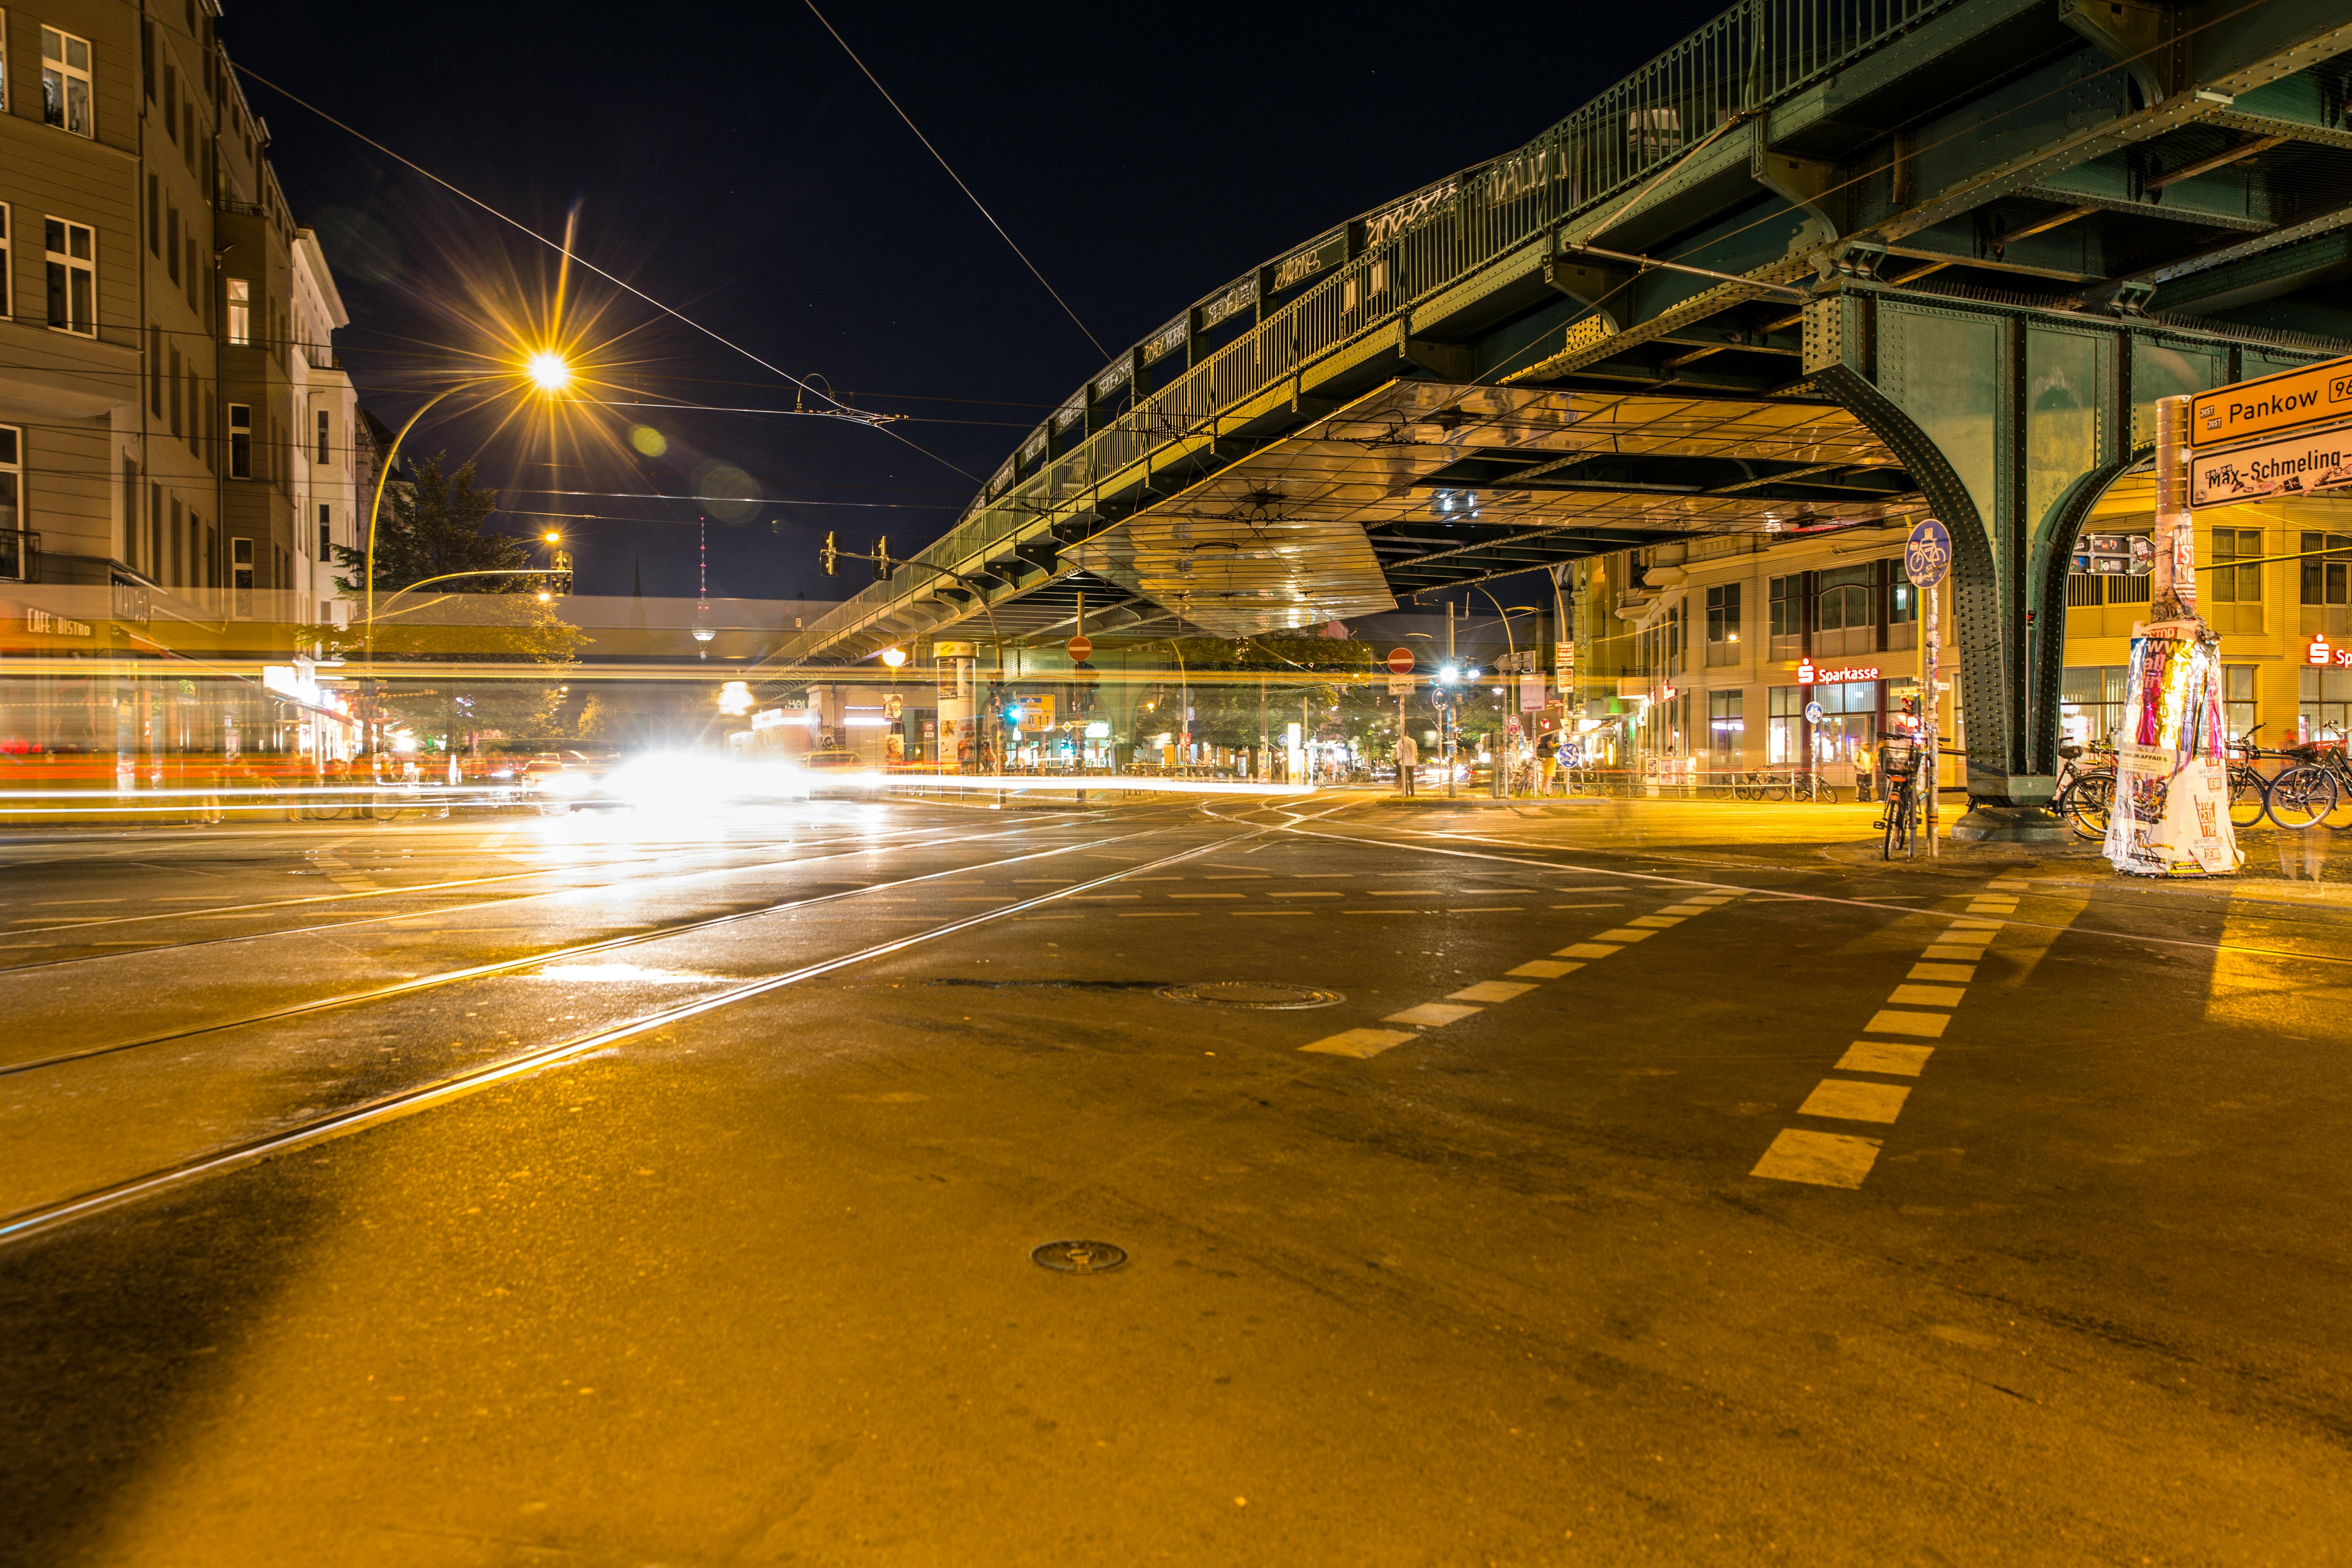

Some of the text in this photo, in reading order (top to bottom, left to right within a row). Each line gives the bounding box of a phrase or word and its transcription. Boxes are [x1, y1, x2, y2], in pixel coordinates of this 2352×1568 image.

[2200, 406, 2214, 416] JUST
[2230, 390, 2318, 423] Pankow
[2208, 419, 2221, 428] JUST
[28, 608, 51, 633] CAFE
[58, 617, 90, 636] BISTRO
[2149, 627, 2175, 639] STOP
[1819, 667, 1878, 685] Sparkasse
[2199, 809, 2215, 823] CETA
[2201, 823, 2216, 837] TTIP
[2205, 849, 2221, 860] DEMO
